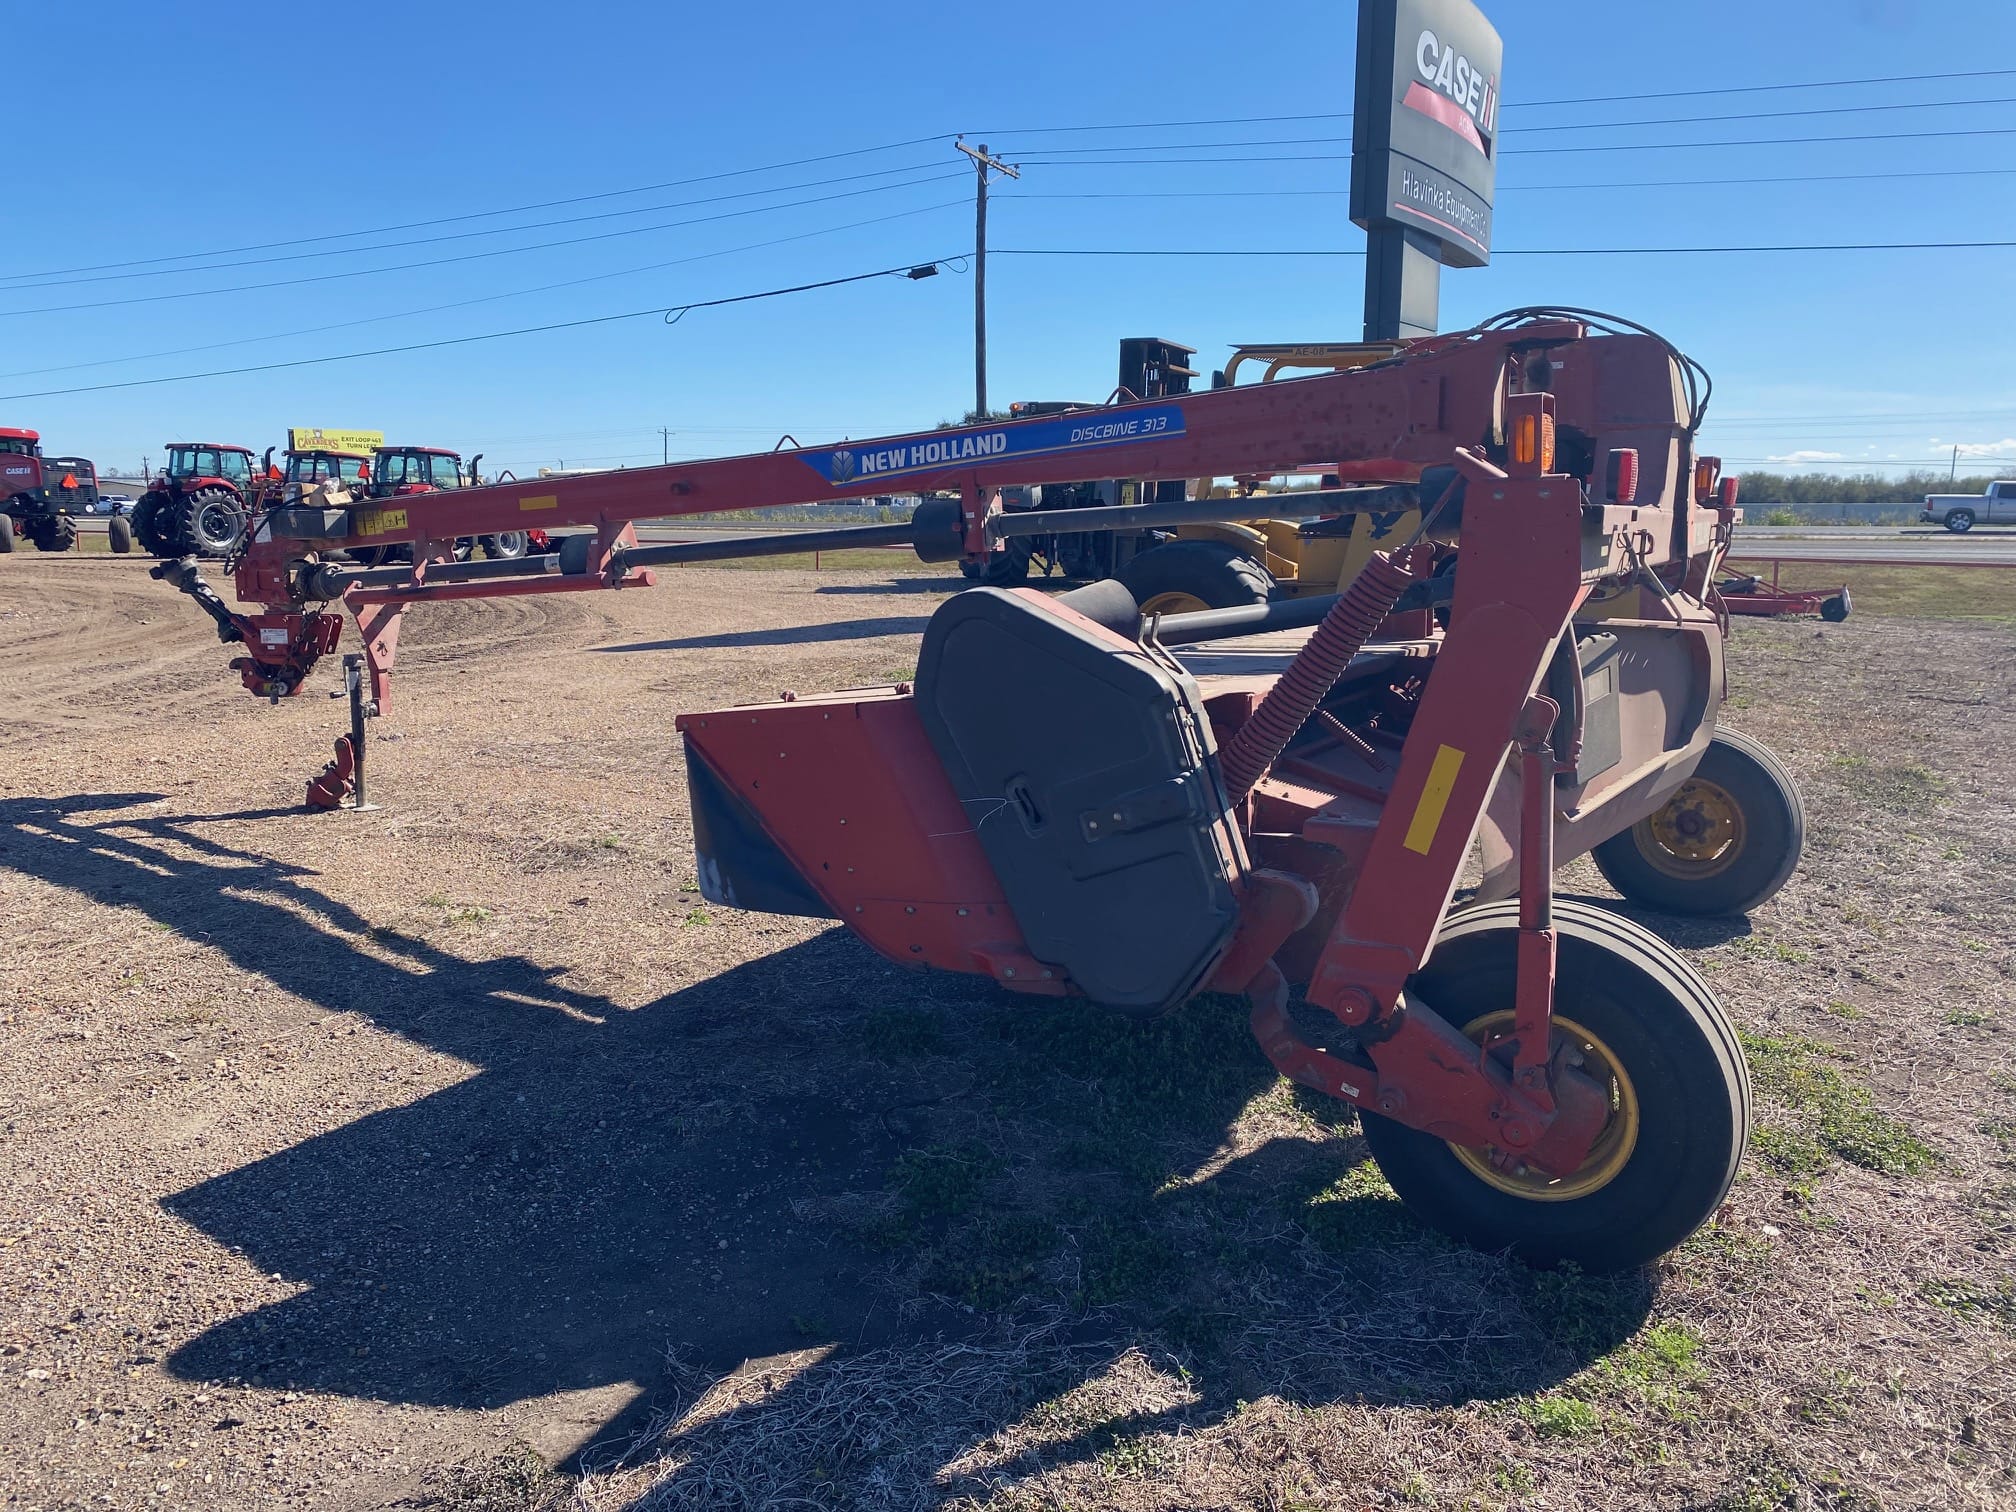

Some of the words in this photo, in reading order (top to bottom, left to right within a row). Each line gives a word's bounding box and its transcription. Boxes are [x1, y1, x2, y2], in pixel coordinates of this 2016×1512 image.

[1416, 30, 1482, 118] CASE
[1402, 170, 1444, 210] Hlavinka
[1446, 190, 1480, 232] Equipment
[1295, 347, 1325, 356] AE-08
[1070, 420, 1138, 442] DISCBINE
[1141, 416, 1167, 433] 313
[861, 448, 906, 474] NEW
[911, 432, 1007, 465] HOLLAND
[6, 467, 24, 475] CASE
